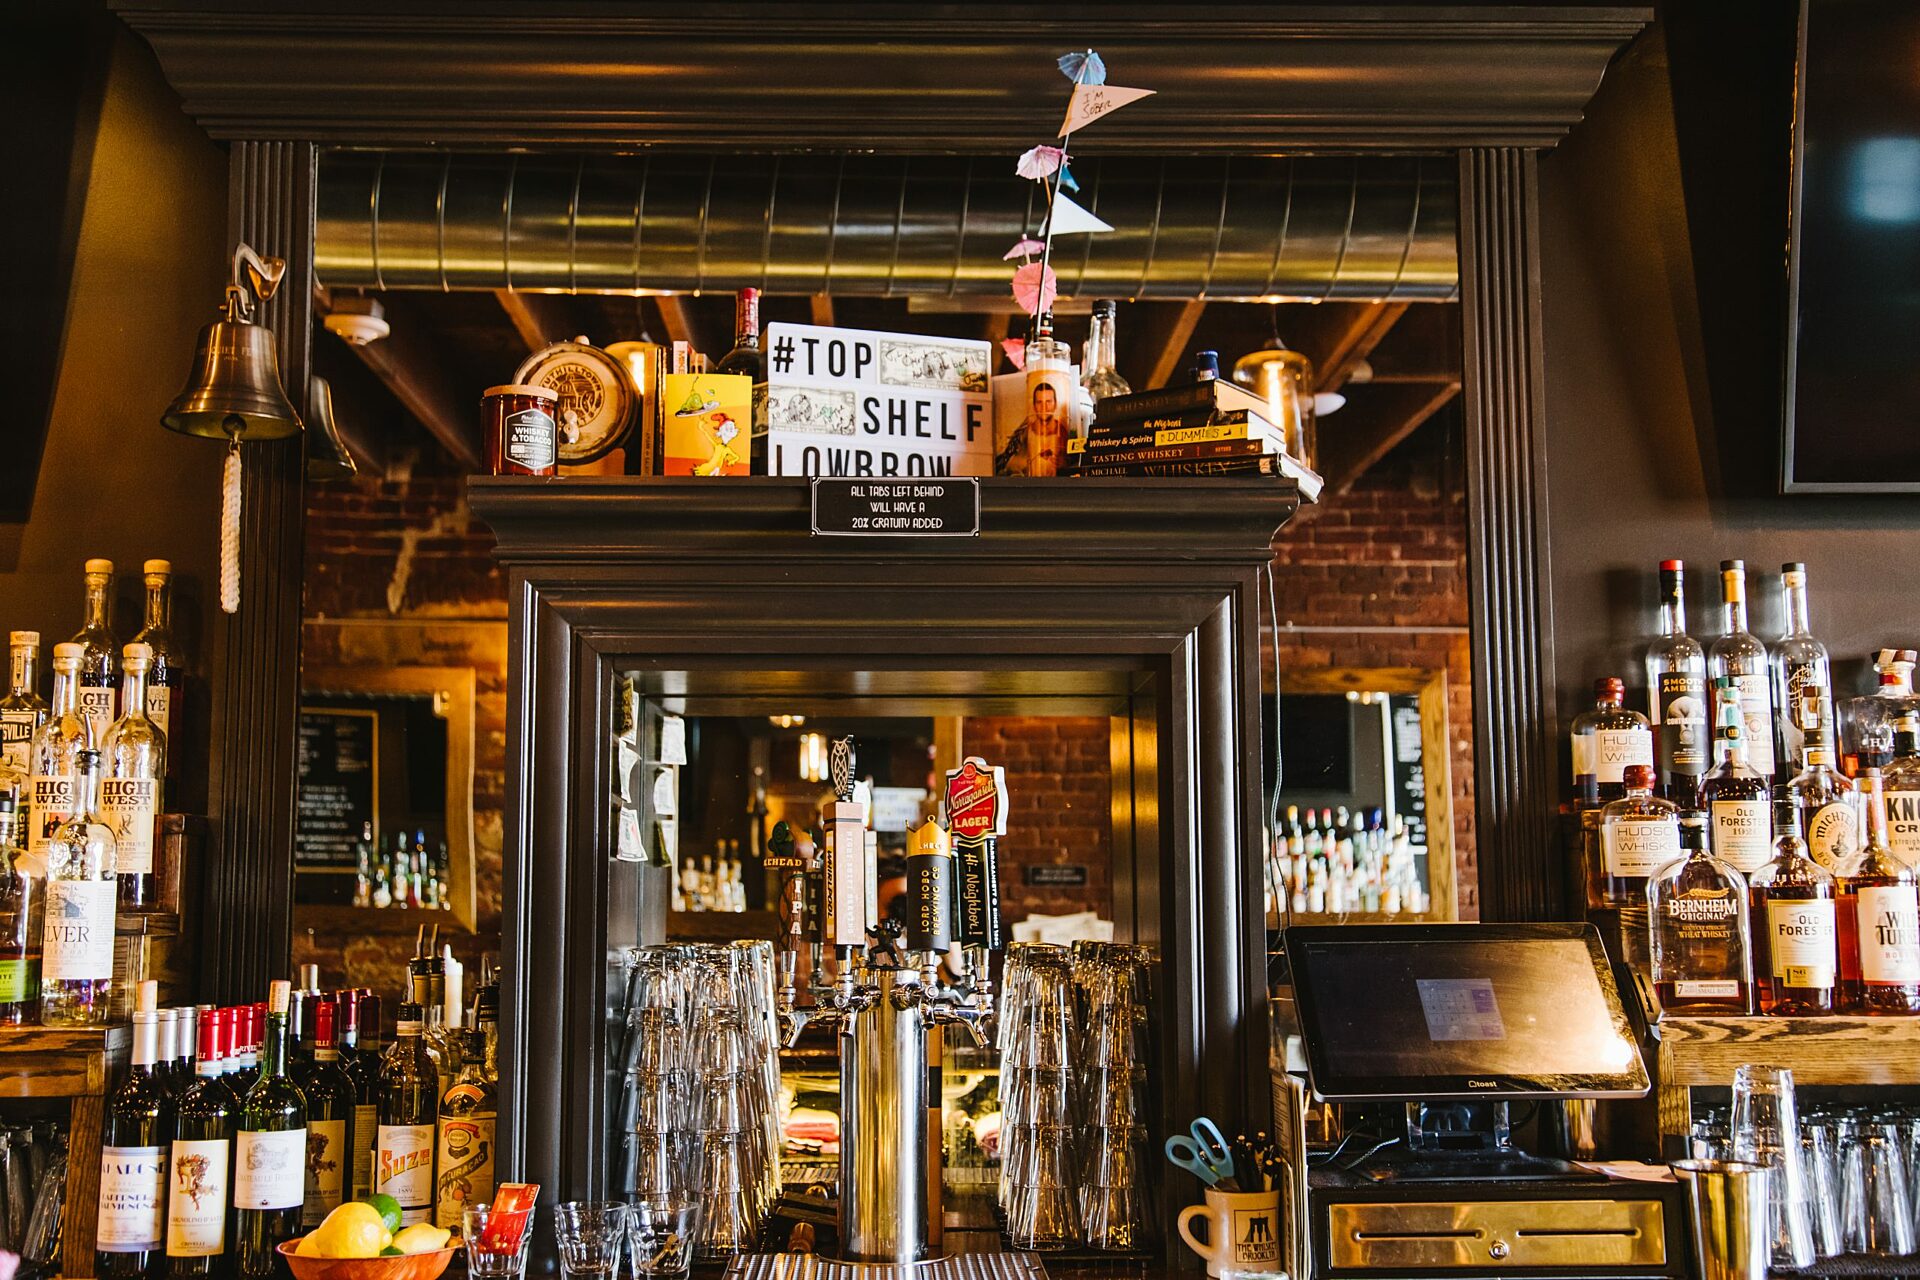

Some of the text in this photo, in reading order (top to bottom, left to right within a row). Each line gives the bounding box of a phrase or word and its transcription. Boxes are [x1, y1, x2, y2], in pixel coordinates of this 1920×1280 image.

[1081, 100, 1112, 119] SOBER
[773, 336, 872, 379] #TOP
[863, 397, 982, 442] SHELF
[515, 427, 550, 437] WHISKEY
[1167, 428, 1219, 442] DUMMIS
[519, 435, 551, 445] TOBACCO
[1089, 435, 1153, 448] Whiskey & Spirits
[1092, 449, 1184, 463] TASTING WHISKEY
[851, 486, 944, 497] ALL TABS LEFT BEHIND
[870, 502, 925, 513] WILL HAVE A
[852, 518, 943, 528] 20% GRATUITY ADDED
[1663, 685, 1704, 693] AMBLER
[80, 706, 110, 714] EST
[149, 699, 165, 711] YE
[1, 724, 31, 740] SVILLE
[1603, 735, 1650, 746] HUDS
[36, 781, 73, 795] HIG
[103, 781, 150, 795] HIGH
[36, 796, 73, 804] WES
[103, 796, 150, 805] WEST
[1736, 808, 1755, 817] OLD
[1887, 797, 1920, 821] KN
[954, 816, 989, 828] LAGER
[1617, 826, 1674, 836] HUDSO
[989, 840, 997, 897] NARRAGANSETT
[921, 869, 930, 933] LORD HOBO
[1669, 899, 1738, 915] BERNHEIM
[790, 880, 803, 935] IPA
[932, 886, 941, 936] BREWING
[1680, 912, 1724, 920] ORIGINAL
[1799, 915, 1819, 925] OLD
[45, 926, 90, 943] LVER
[1778, 924, 1833, 936] FORESER
[1678, 984, 1684, 995] 7
[1476, 1080, 1497, 1088] toast
[380, 1149, 430, 1185] Suze
[528, 1186, 538, 1202] VISA
[1238, 1244, 1251, 1252] THE
